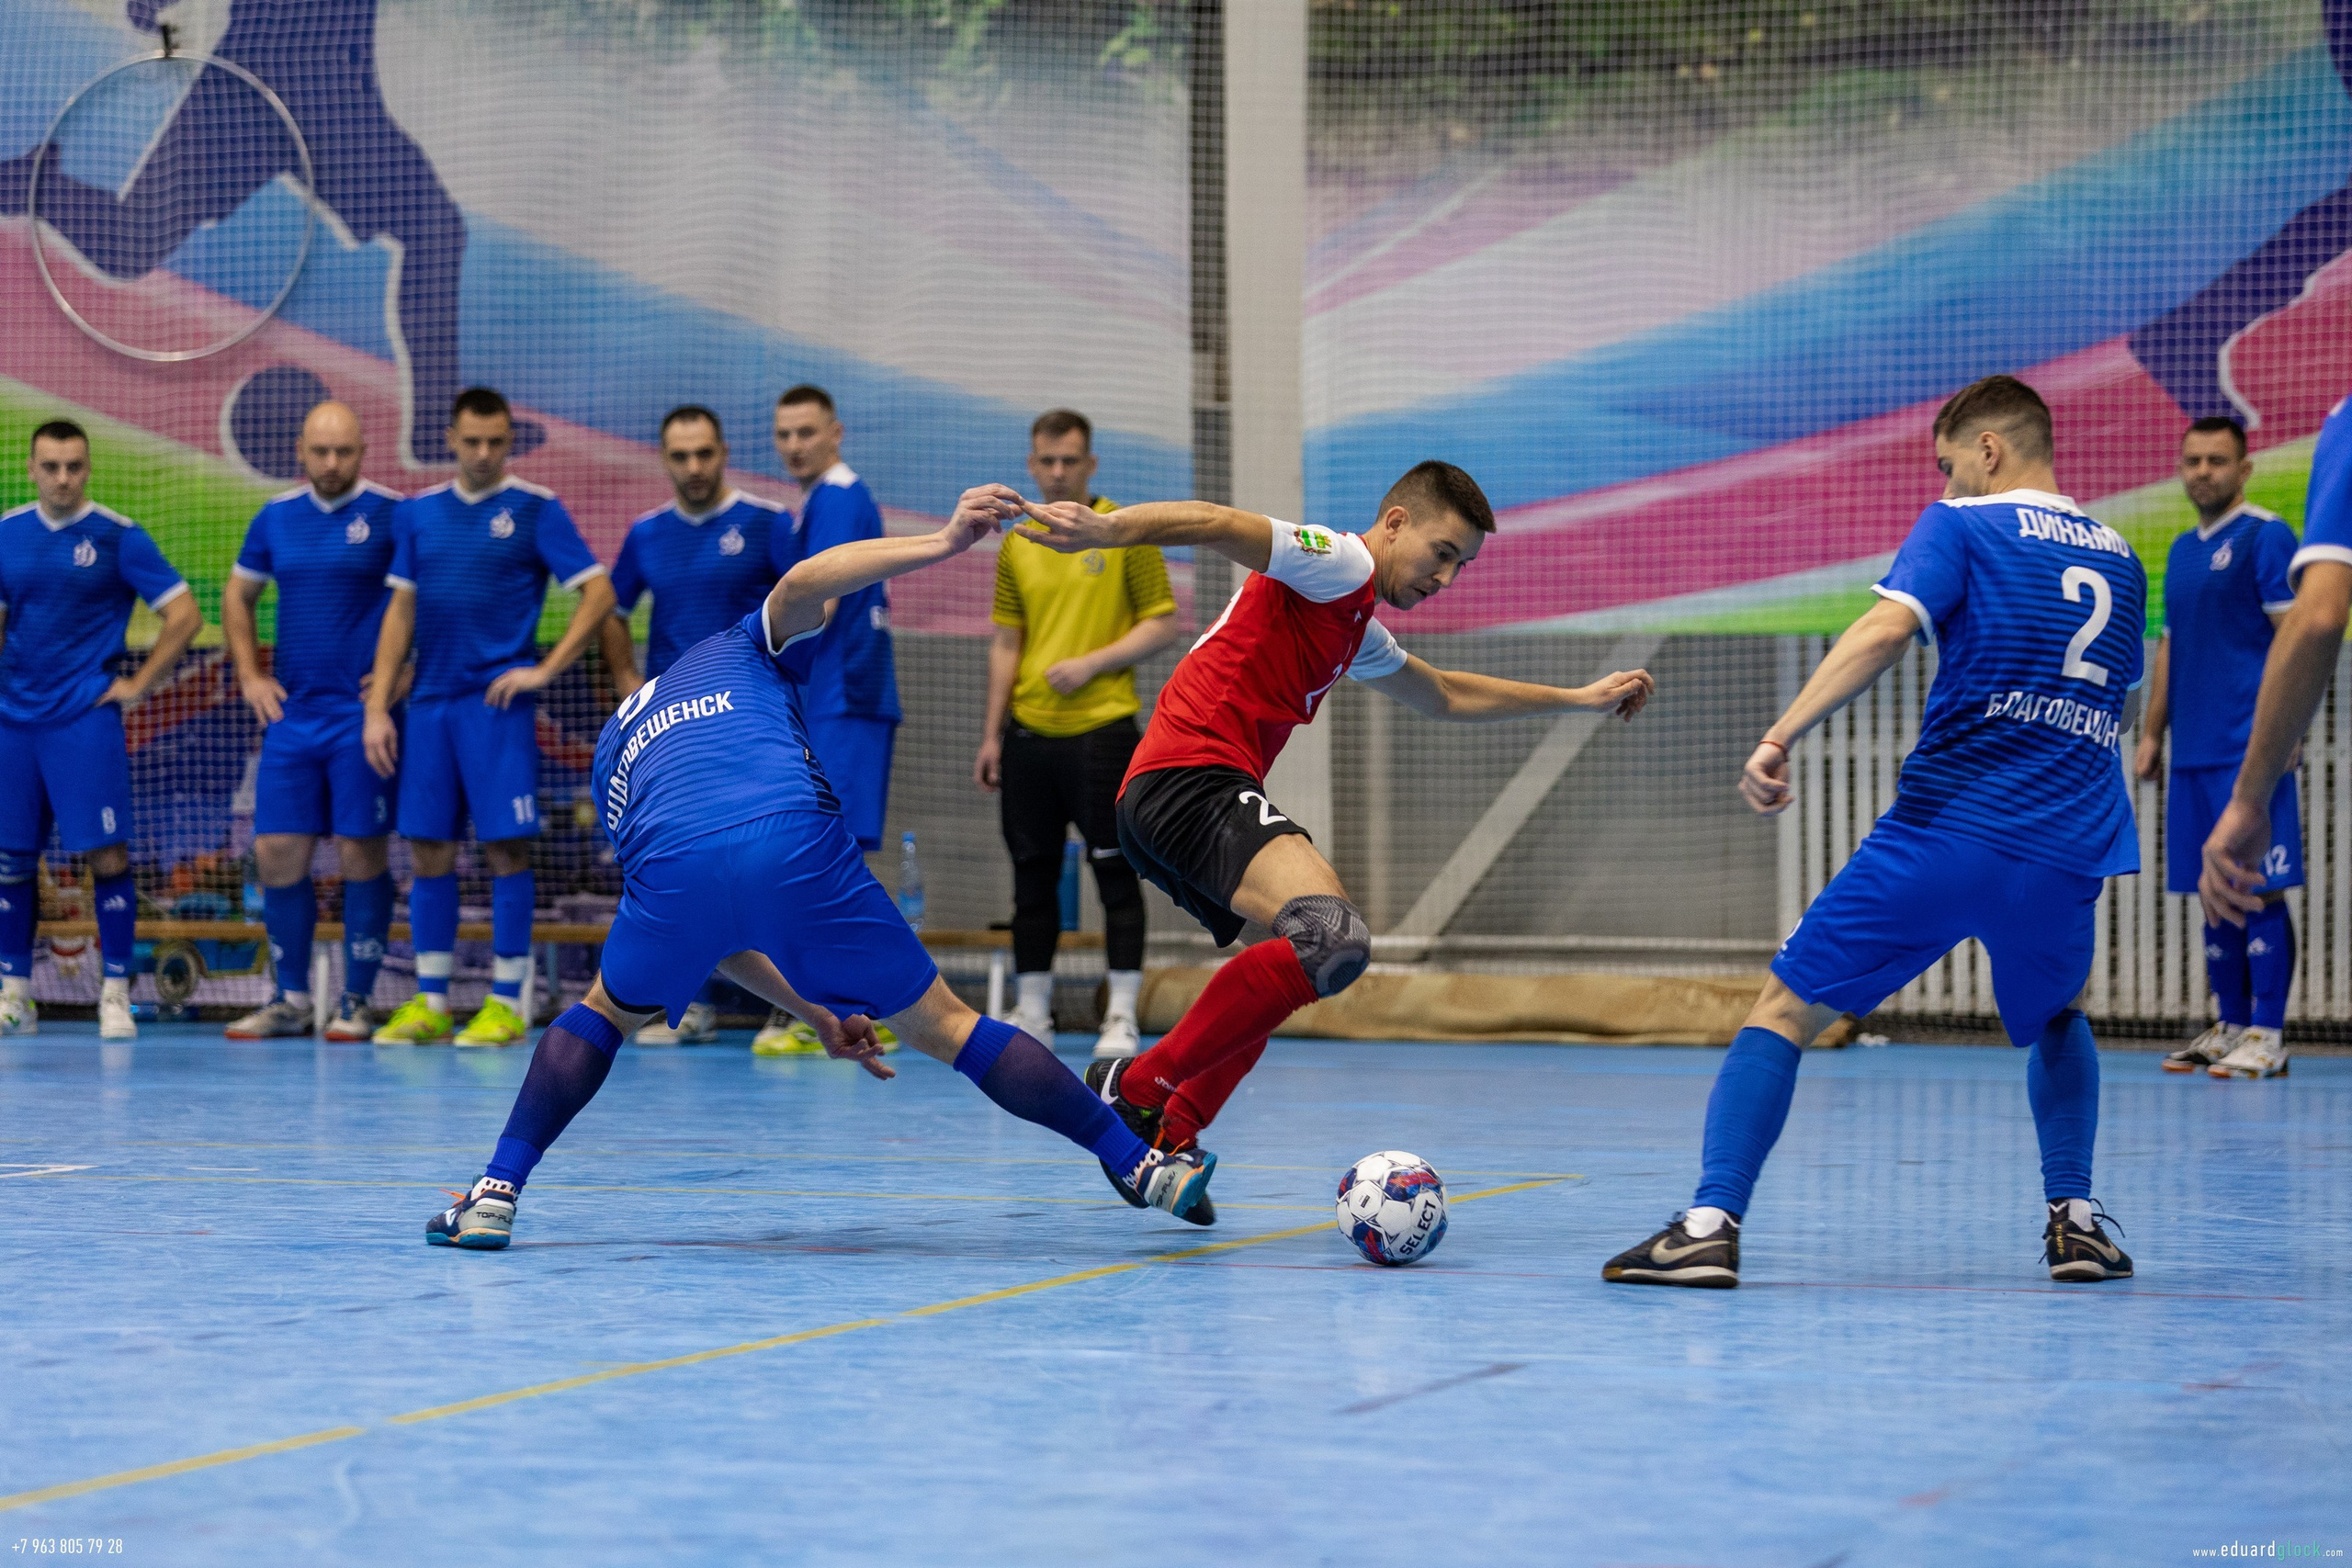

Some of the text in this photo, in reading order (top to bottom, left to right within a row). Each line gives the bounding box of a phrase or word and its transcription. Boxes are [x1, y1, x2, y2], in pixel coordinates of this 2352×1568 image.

[2061, 566, 2112, 687] 2
[1238, 791, 1288, 826] 2
[2263, 843, 2292, 877] 12
[1399, 1200, 1436, 1256] SELECT
